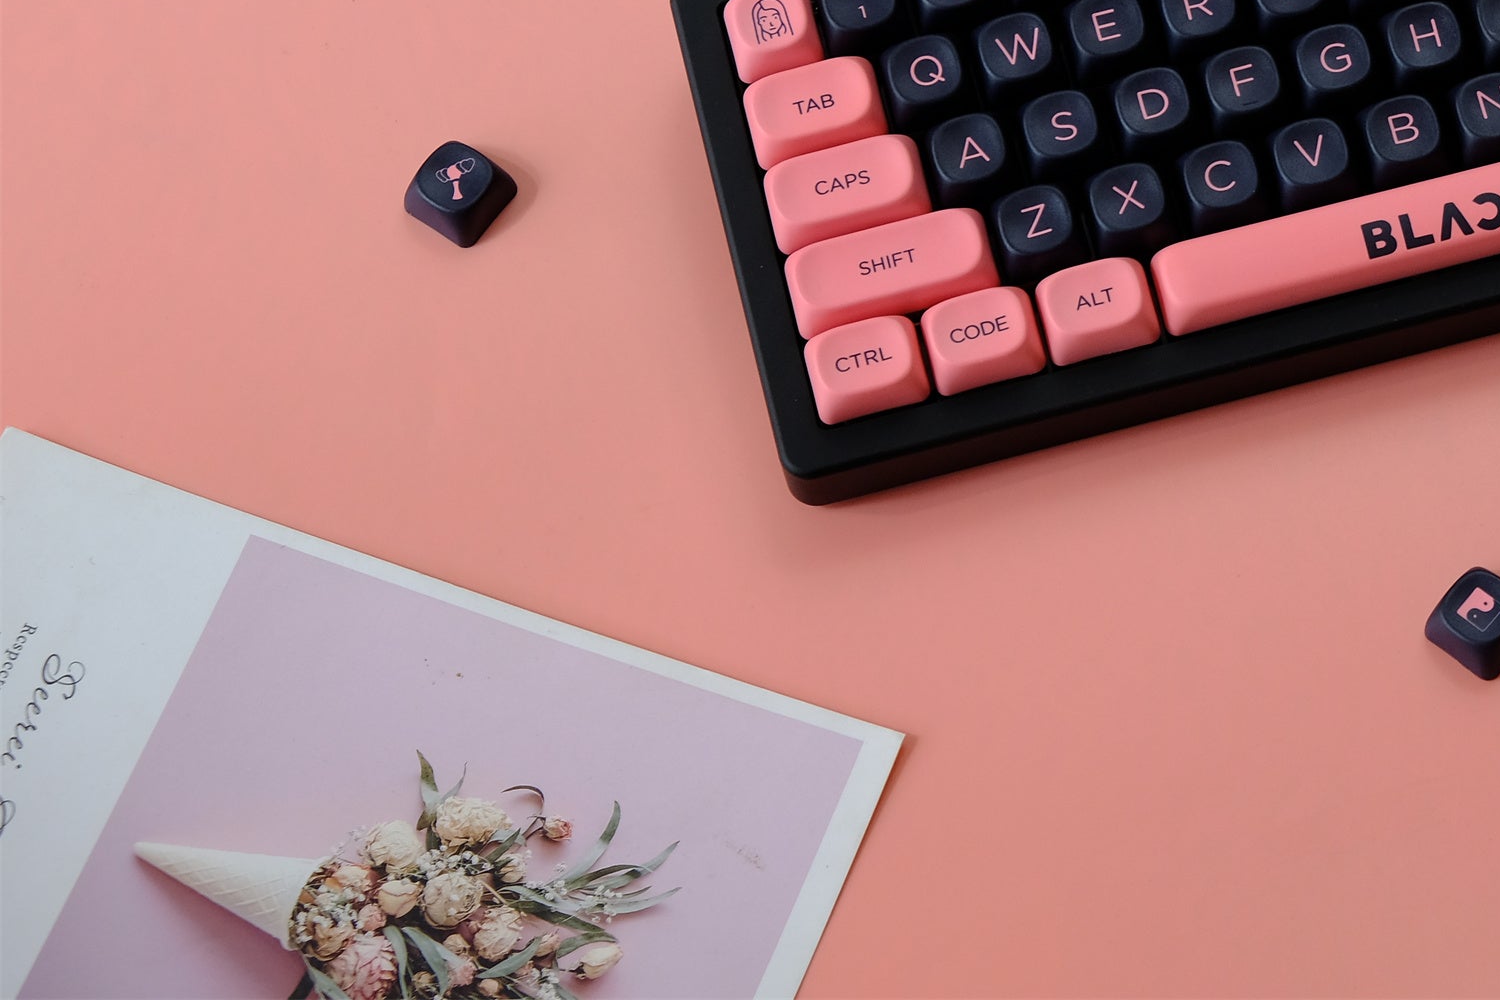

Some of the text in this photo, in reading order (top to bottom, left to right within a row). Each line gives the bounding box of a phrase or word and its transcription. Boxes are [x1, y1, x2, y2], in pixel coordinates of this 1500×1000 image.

[1091, 8, 1121, 42] E
[1409, 18, 1442, 53] H
[994, 27, 1039, 65] W
[1320, 42, 1352, 73] G
[910, 55, 946, 86] Q
[1229, 63, 1254, 97] F
[792, 93, 835, 115] TAB
[1137, 88, 1169, 120] D
[1051, 111, 1078, 141] S
[1387, 112, 1420, 145] B
[959, 136, 991, 169] A
[1293, 134, 1323, 167] V
[814, 170, 871, 196] CAPS
[1204, 160, 1236, 192] C
[1112, 180, 1145, 215] X
[1020, 203, 1053, 239] Z
[858, 248, 915, 276] SHIFT
[1076, 287, 1113, 311] ALT
[949, 315, 1009, 344] CODE
[835, 347, 893, 373] CTRL
